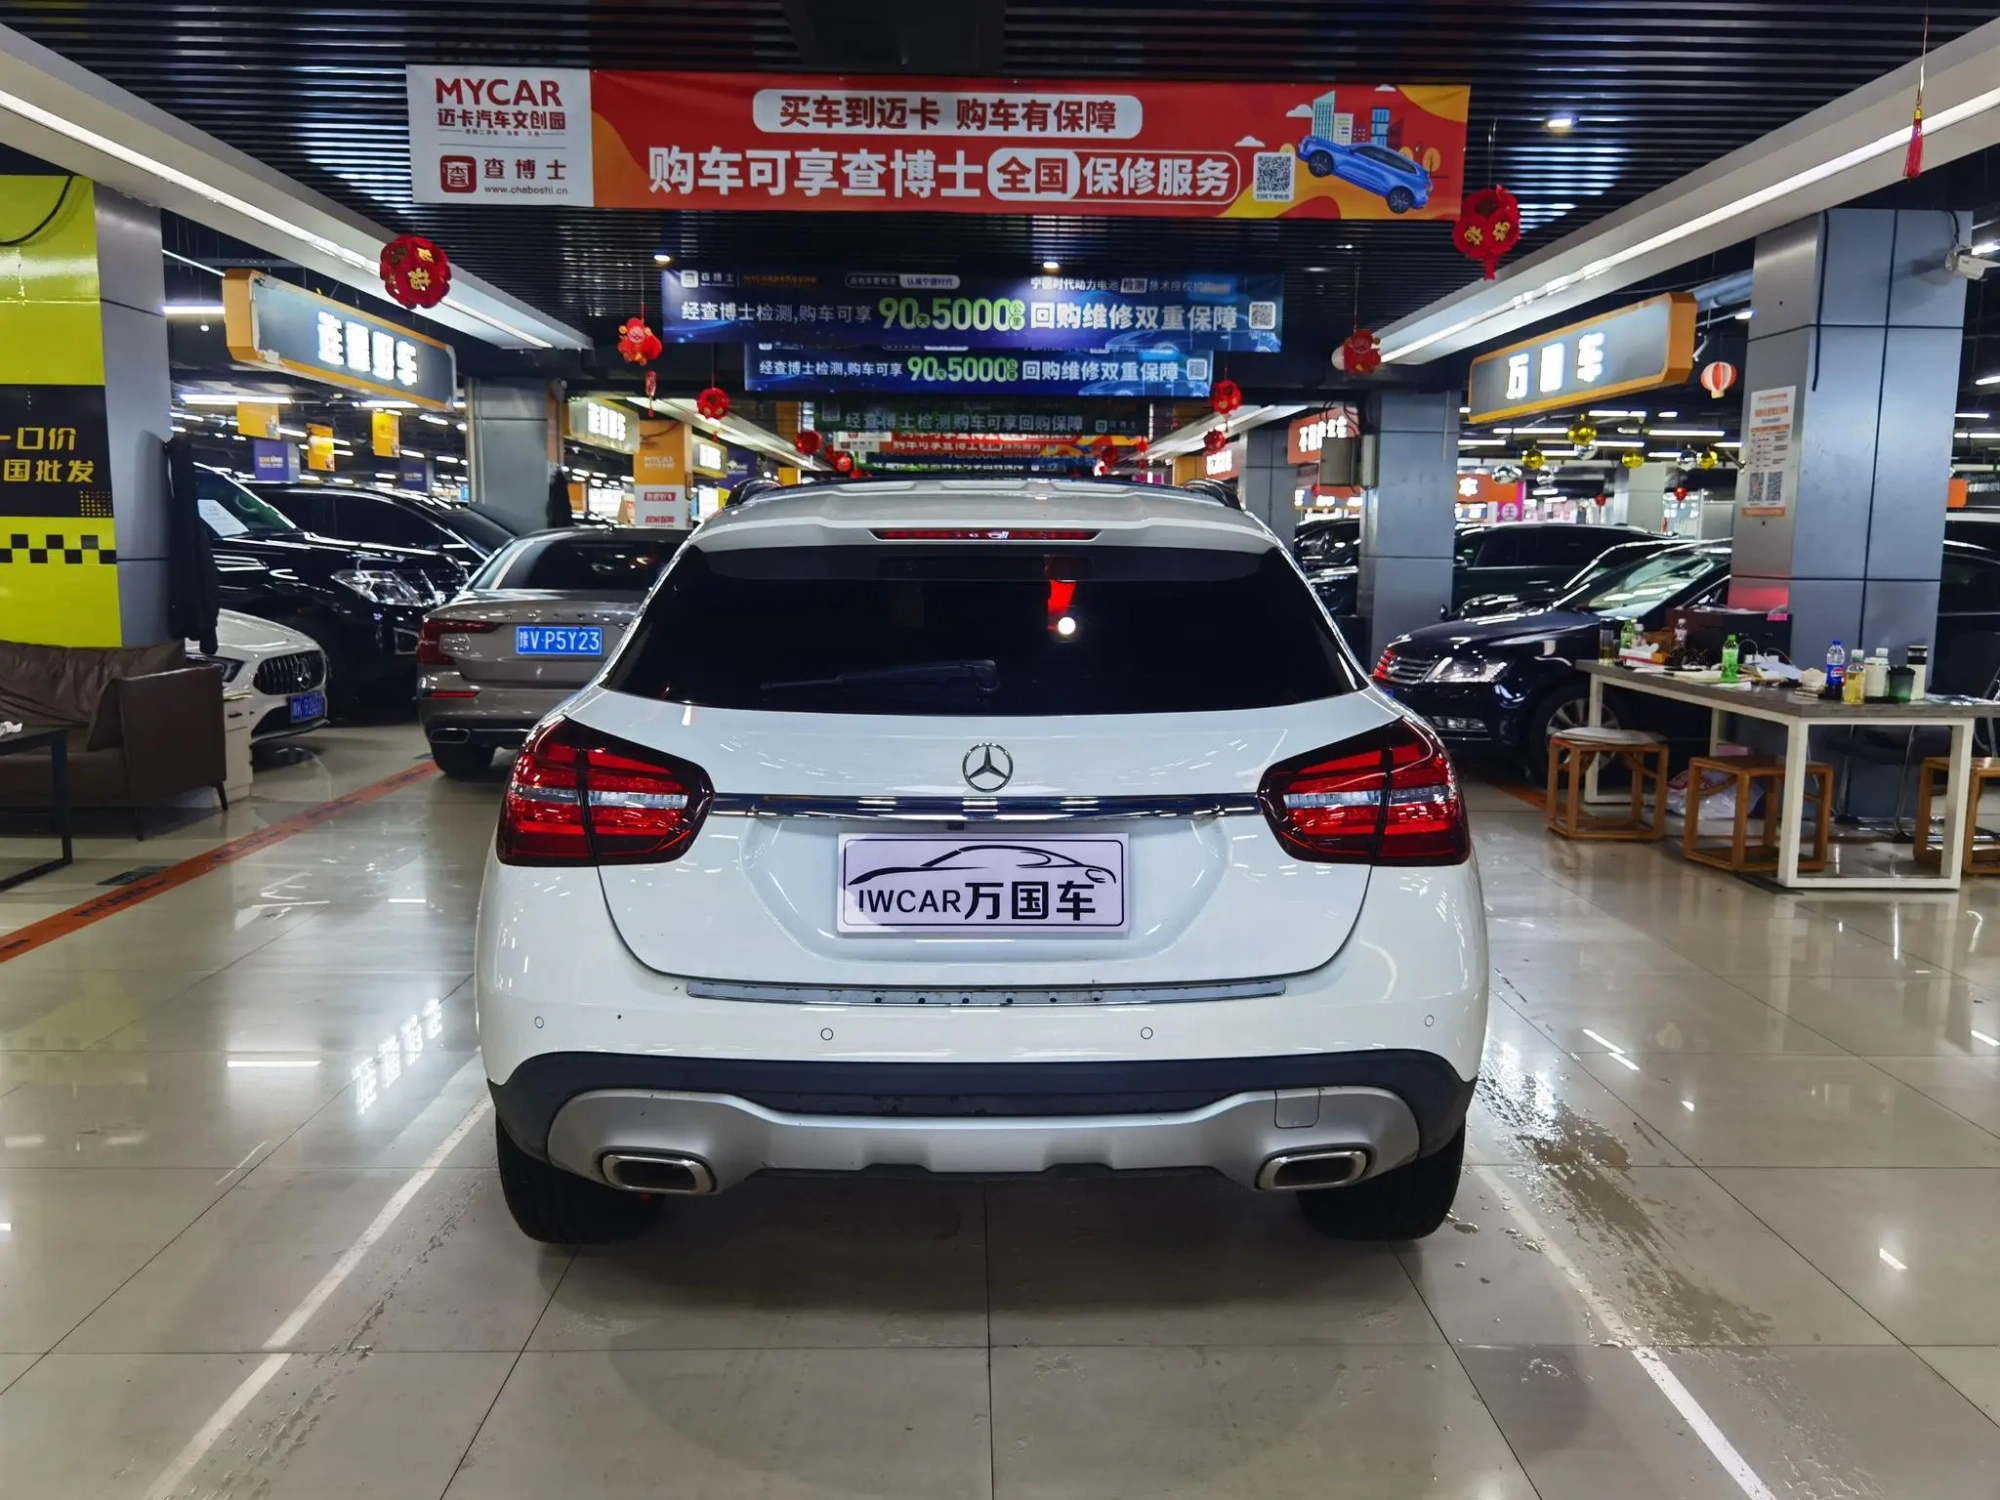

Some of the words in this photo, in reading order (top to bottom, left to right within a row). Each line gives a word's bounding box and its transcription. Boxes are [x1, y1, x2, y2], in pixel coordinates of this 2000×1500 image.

[435, 77, 563, 107] MYCAR
[437, 108, 566, 130] 迈卡汽车文创园
[780, 94, 941, 130] 买车到迈卡
[956, 99, 1117, 133] 购车有保障
[484, 158, 567, 181] 查博士
[648, 145, 983, 197] 购车可享查博士
[996, 156, 1069, 195] 全国
[1083, 156, 1231, 196] 保修服务
[484, 186, 569, 196] www.chaboshi.cn
[681, 300, 873, 324] 经查博士检测,购车可享
[1030, 301, 1238, 331] 回购维修双重保障
[759, 361, 904, 378] 经查博士检测,购车可享
[1022, 360, 1179, 382] 回购维修双重保障
[858, 888, 961, 913] IWCAR
[964, 880, 1097, 921] 万国车
